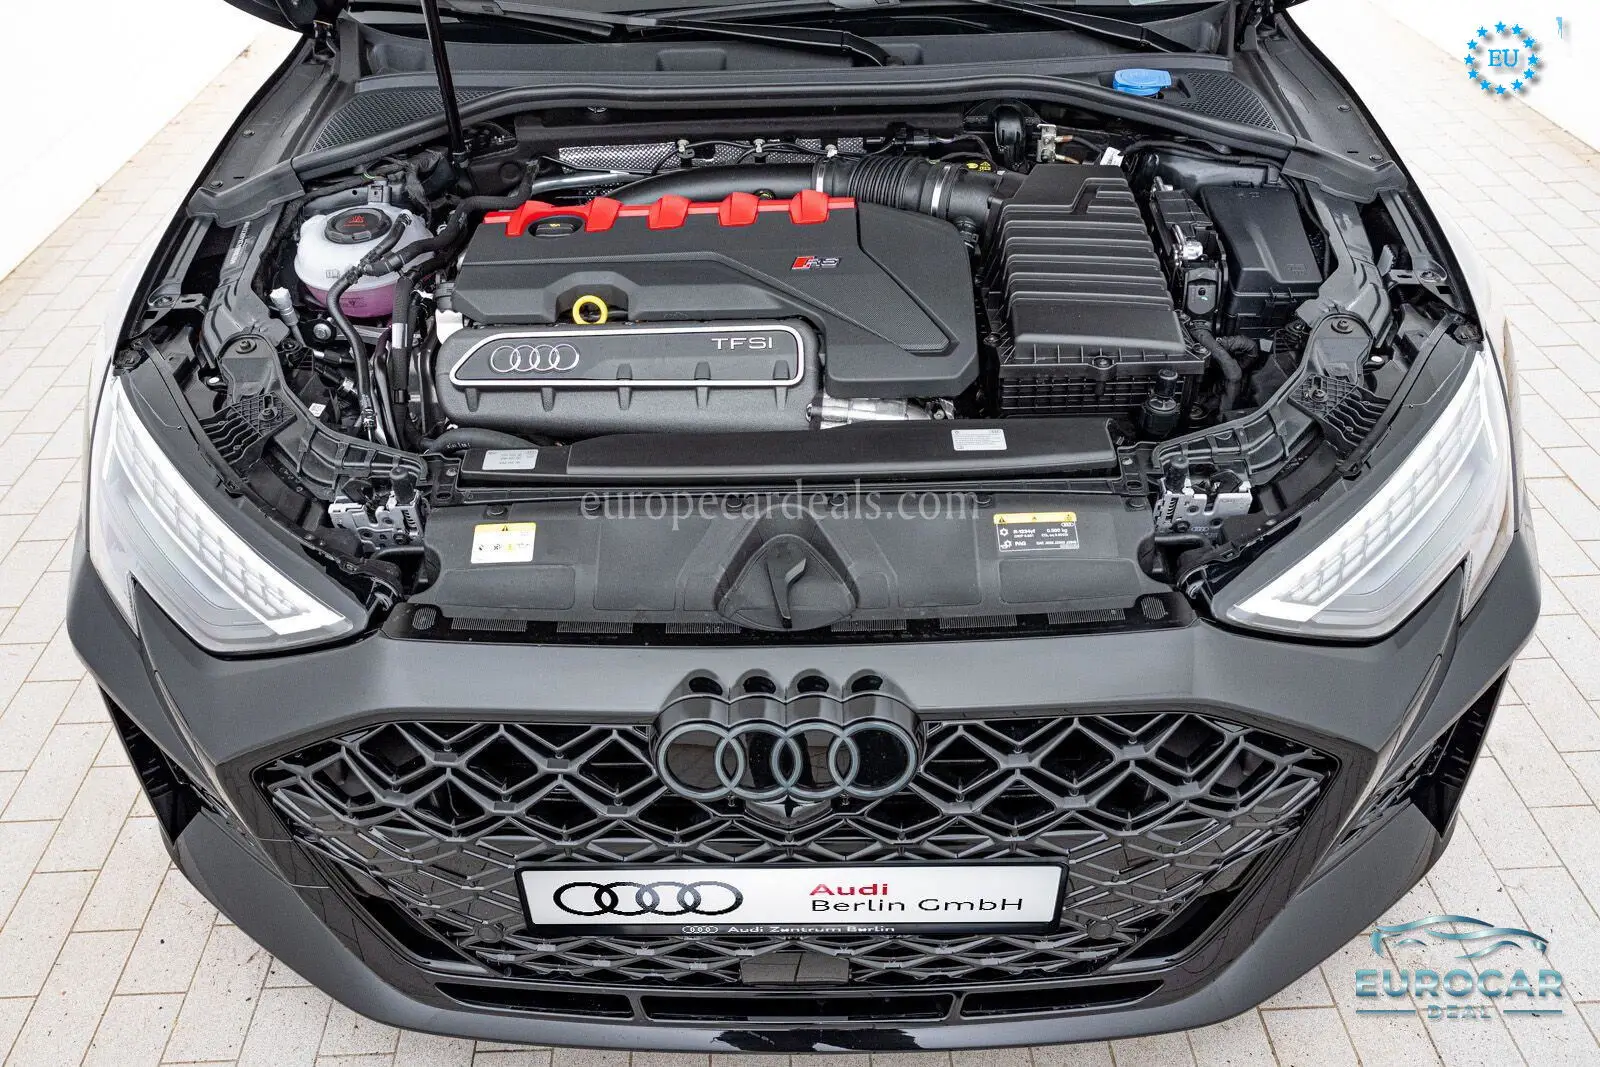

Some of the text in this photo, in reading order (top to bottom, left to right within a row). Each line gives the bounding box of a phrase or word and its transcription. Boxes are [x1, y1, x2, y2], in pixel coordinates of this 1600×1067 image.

[799, 256, 839, 268] RS
[711, 337, 773, 350] TFSI
[809, 883, 888, 896] Audi
[811, 898, 1023, 912] Berlin GmbH
[727, 925, 896, 933] Audi Zentrum Berlin
